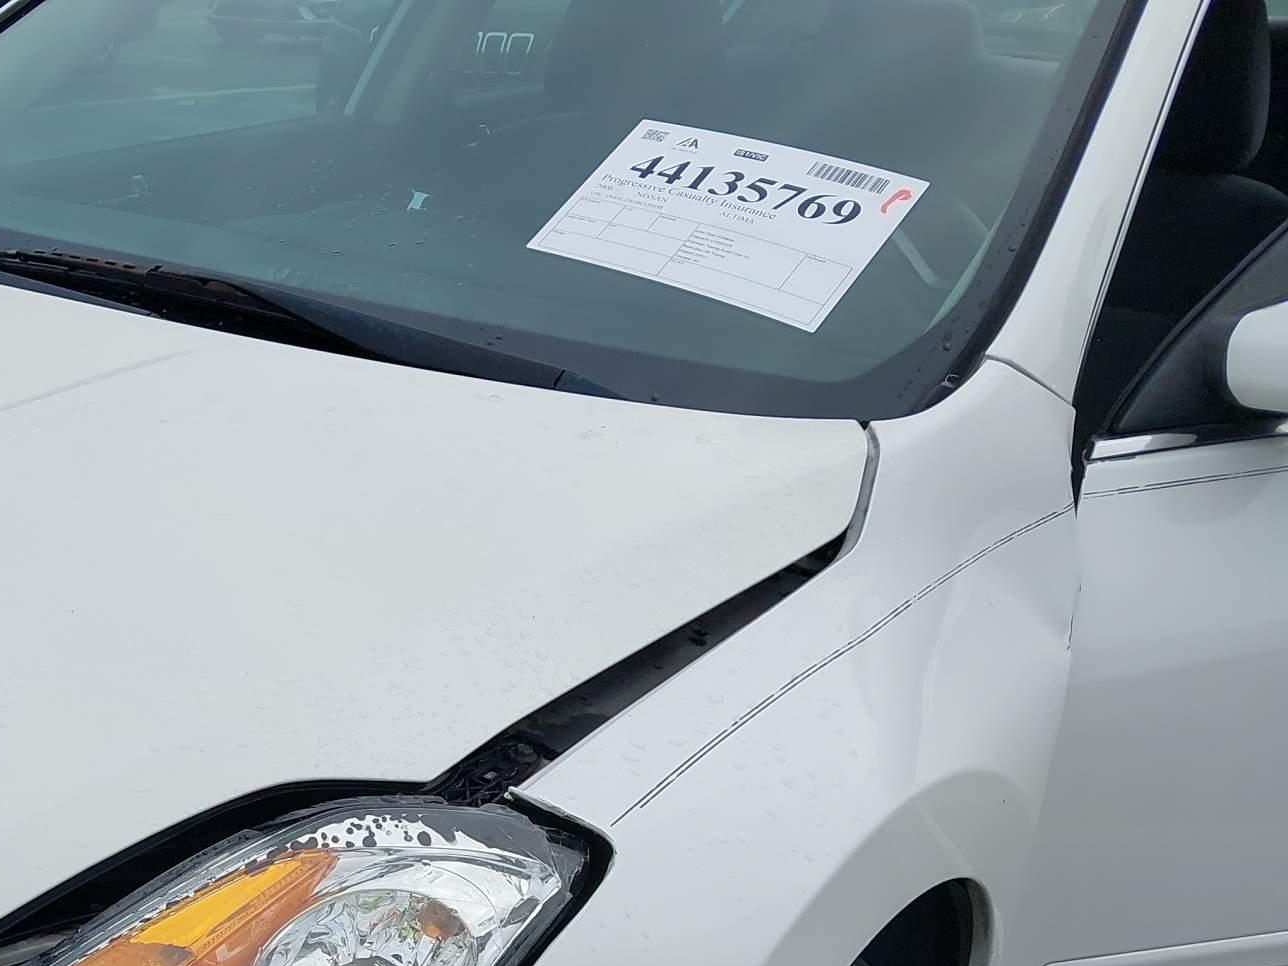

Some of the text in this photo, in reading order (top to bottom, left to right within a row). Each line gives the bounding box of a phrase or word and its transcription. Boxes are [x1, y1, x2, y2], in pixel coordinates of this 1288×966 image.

[601, 173, 666, 193] Progressive
[668, 186, 718, 206] Casualty
[719, 200, 777, 220] Insurance
[630, 155, 862, 225] 44135769
